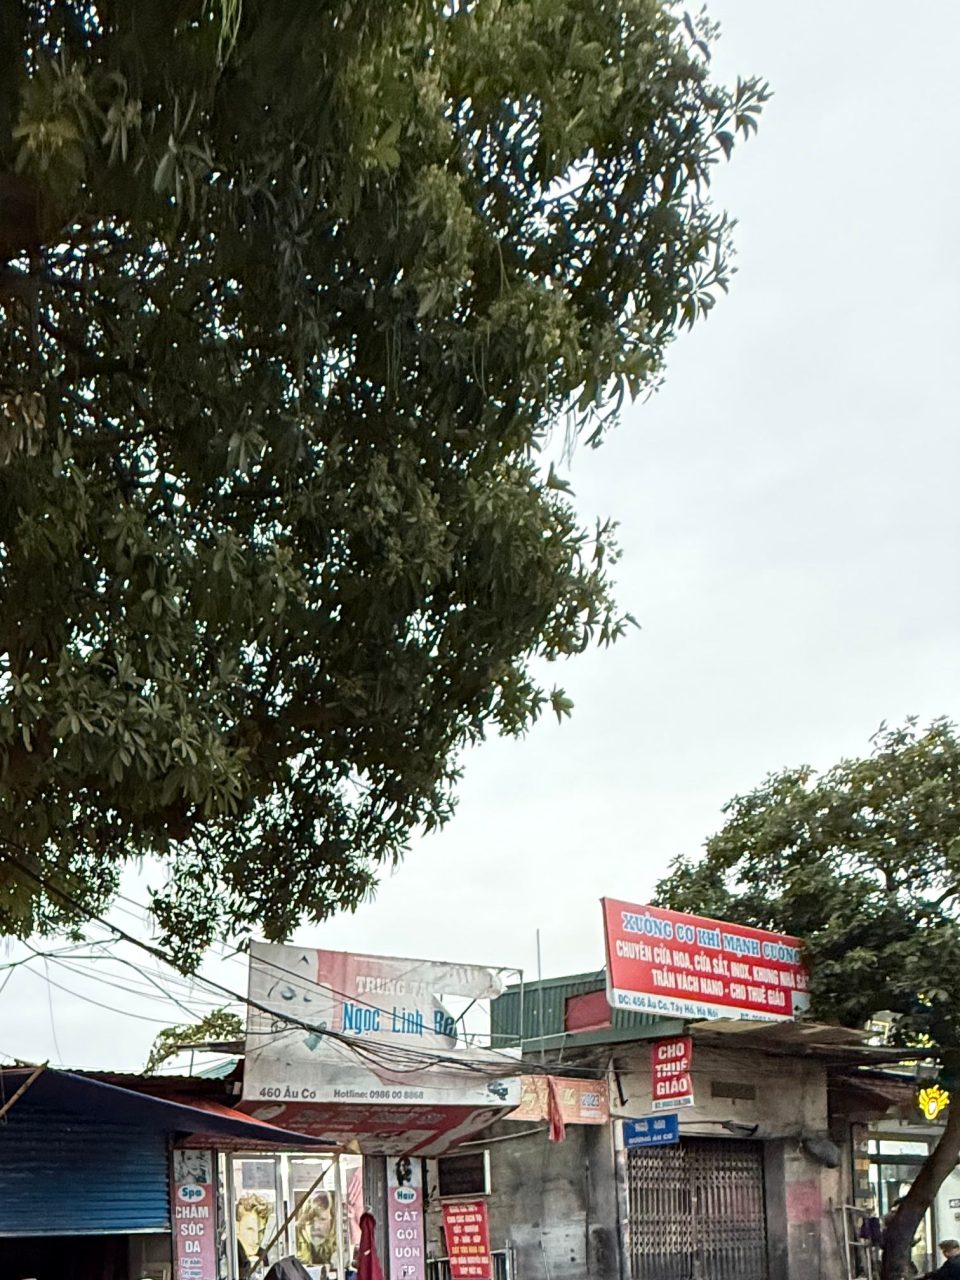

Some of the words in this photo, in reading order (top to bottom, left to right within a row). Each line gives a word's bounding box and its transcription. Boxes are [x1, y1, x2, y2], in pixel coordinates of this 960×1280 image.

[697, 928, 721, 948] KHÍ
[722, 933, 761, 958] MẠNH
[355, 976, 406, 996] TRUNG
[342, 1001, 380, 1036] Ngọc
[392, 1006, 423, 1038] Linh
[658, 1042, 685, 1060] CHO
[655, 1057, 689, 1078] THUÊ
[259, 1087, 281, 1098] 460
[283, 1085, 299, 1098] Âu
[333, 1089, 368, 1099] Hotline:
[656, 1077, 688, 1096] GIÁO
[181, 1187, 202, 1200] Spa
[397, 1190, 415, 1200] Hair
[175, 1203, 209, 1219] CHĂM
[180, 1221, 204, 1236] SÓC
[185, 1240, 201, 1253] DA
